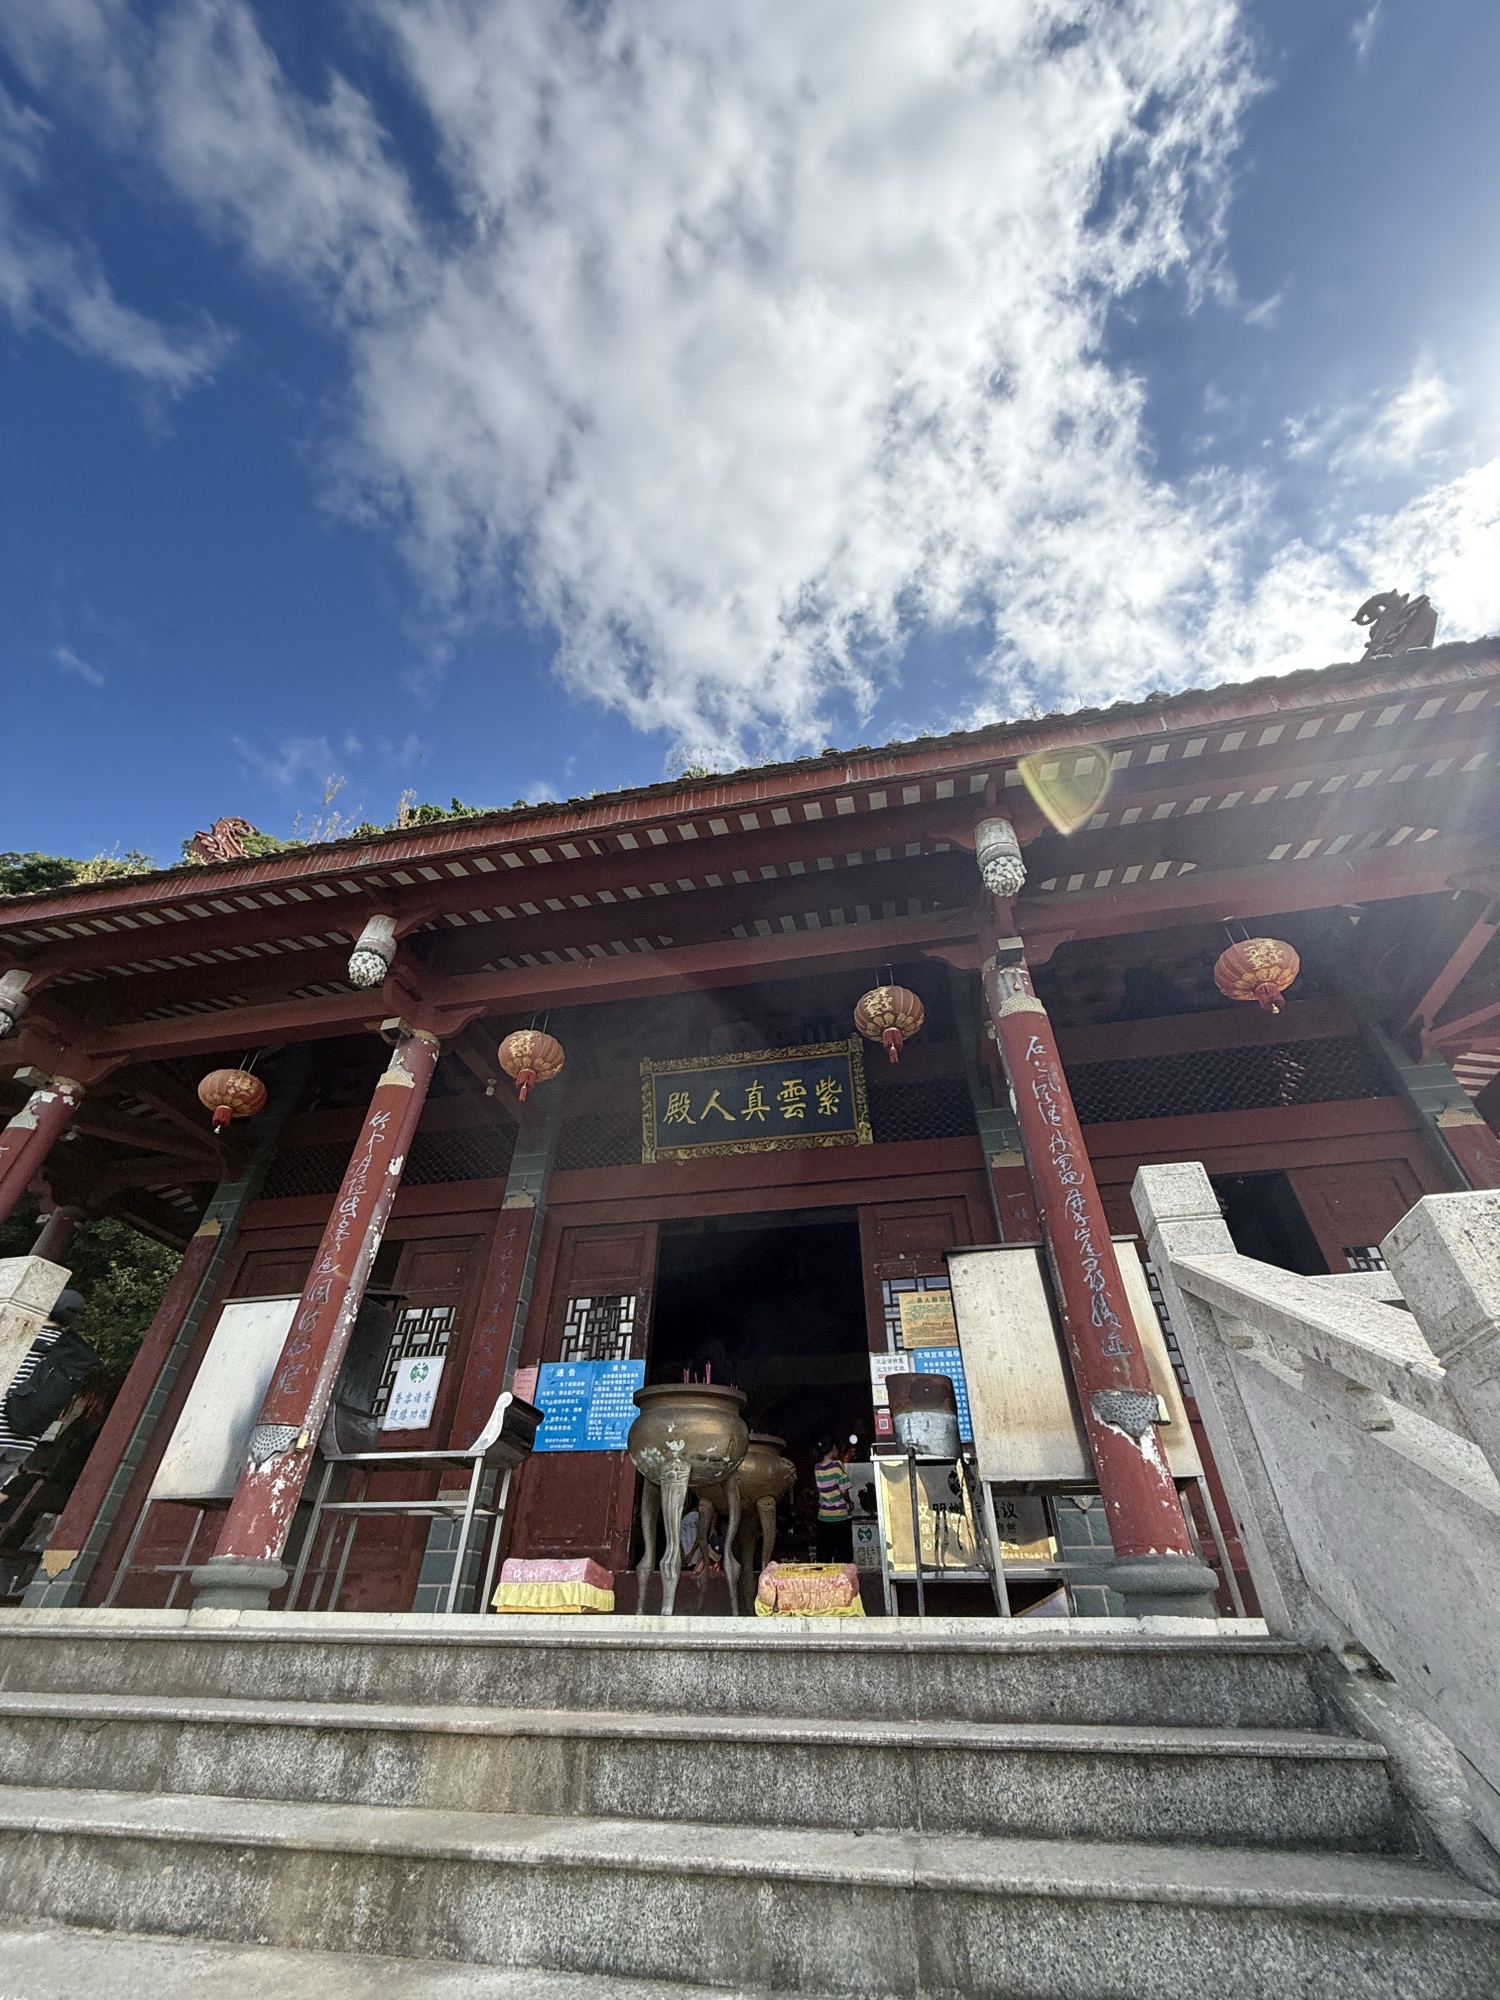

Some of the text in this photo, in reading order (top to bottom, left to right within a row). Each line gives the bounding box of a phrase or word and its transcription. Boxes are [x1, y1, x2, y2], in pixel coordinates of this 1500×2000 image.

[663, 1075, 843, 1125] 紫雲真人殿
